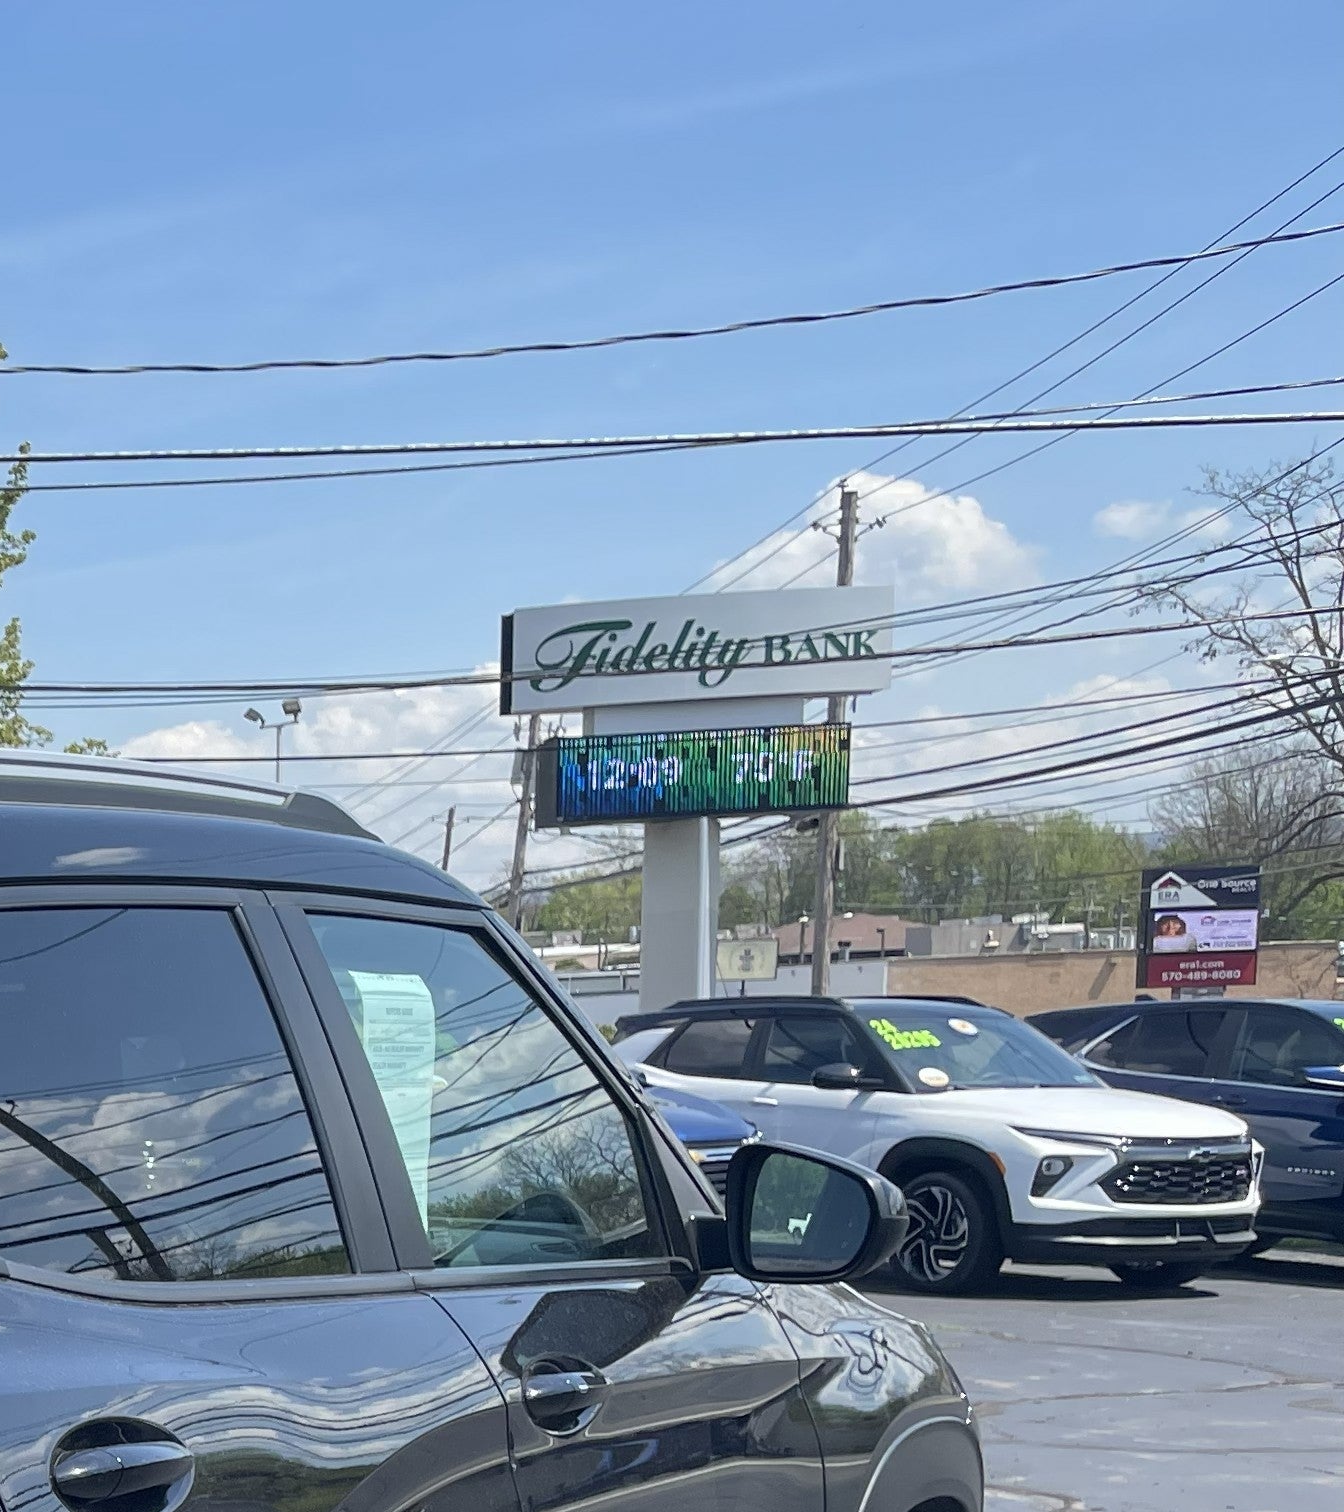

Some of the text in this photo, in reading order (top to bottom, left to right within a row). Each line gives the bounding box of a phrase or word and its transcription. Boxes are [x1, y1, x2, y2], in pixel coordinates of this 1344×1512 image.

[530, 619, 879, 692] Fidelity BANK
[1197, 878, 1257, 889] One Source
[1157, 891, 1180, 902] ERA
[1179, 960, 1224, 969] era1.com
[869, 1018, 898, 1036] 24
